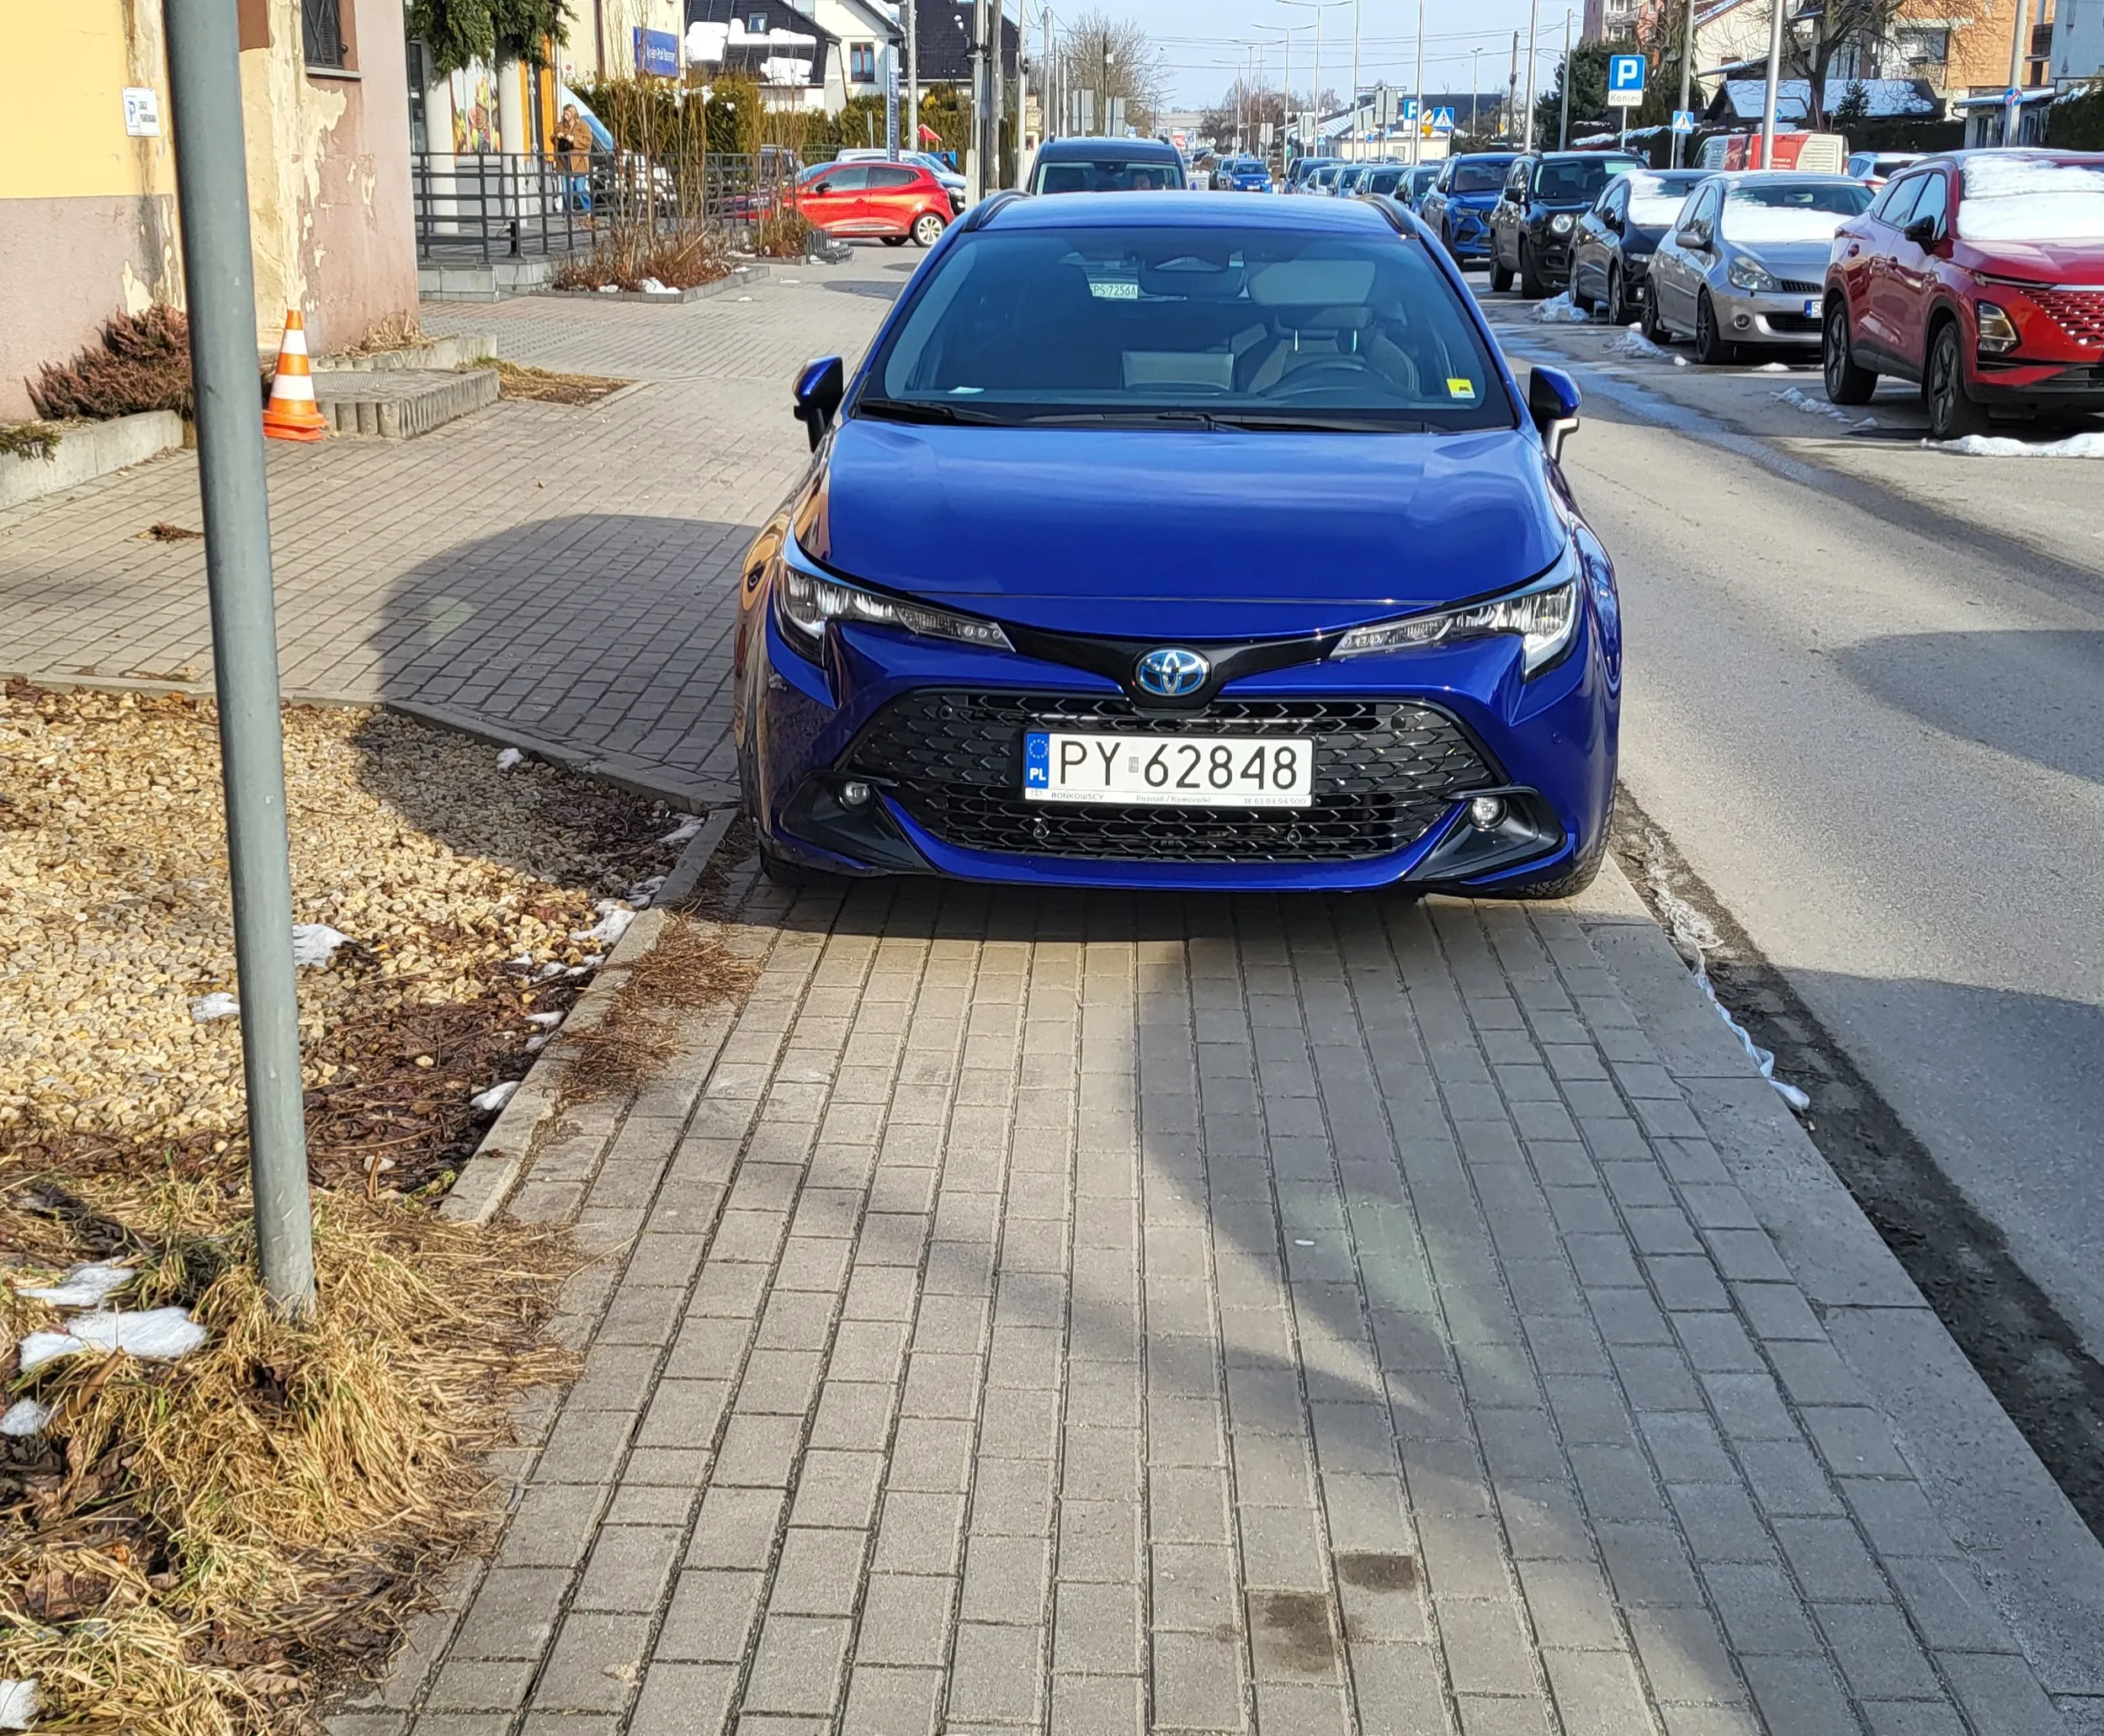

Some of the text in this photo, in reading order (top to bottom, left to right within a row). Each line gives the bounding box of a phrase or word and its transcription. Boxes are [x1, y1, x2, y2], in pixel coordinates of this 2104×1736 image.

[1618, 60, 1638, 87] P
[1610, 93, 1640, 103] Koniec
[1029, 767, 1047, 781] PL
[1060, 741, 1297, 789] PY 62848
